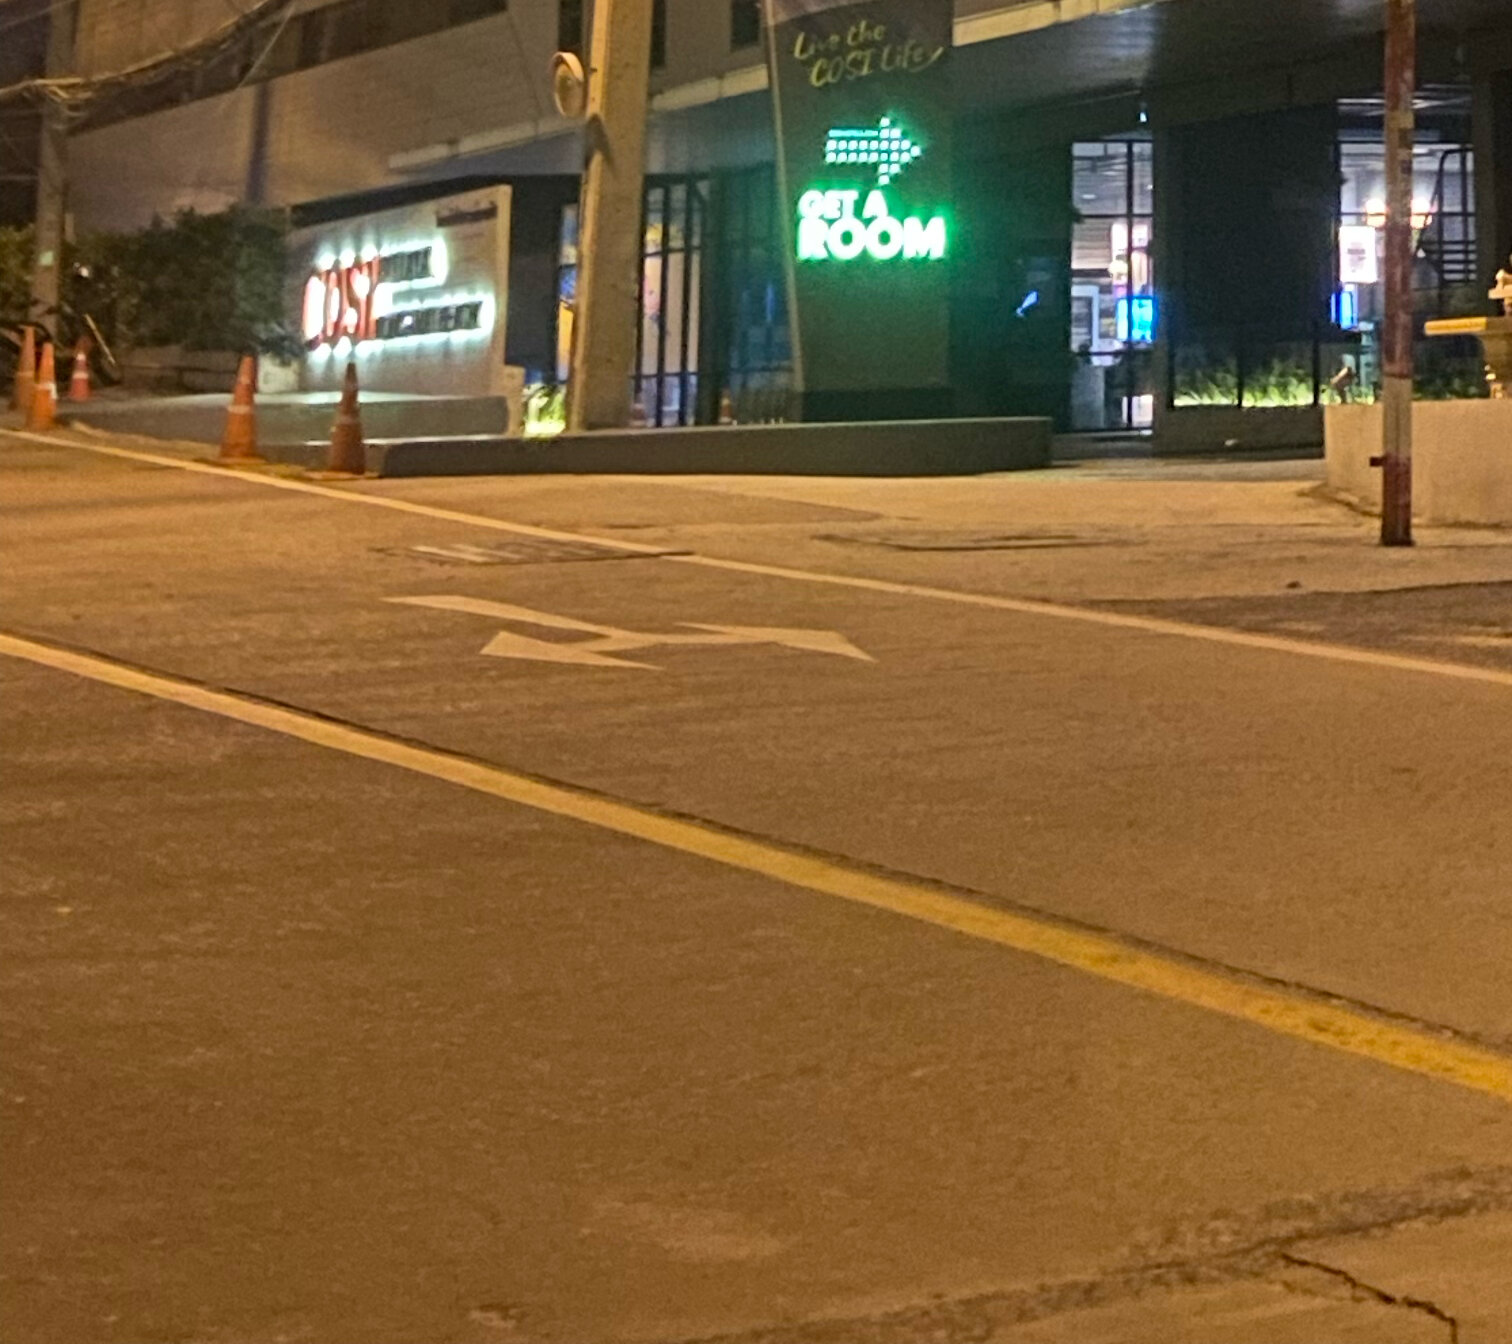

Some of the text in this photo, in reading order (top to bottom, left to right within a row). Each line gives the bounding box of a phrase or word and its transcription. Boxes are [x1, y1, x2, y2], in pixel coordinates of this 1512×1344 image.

[847, 20, 886, 45] the
[810, 48, 873, 87] COSI
[798, 189, 889, 219] GET A
[797, 215, 947, 260] ROOM
